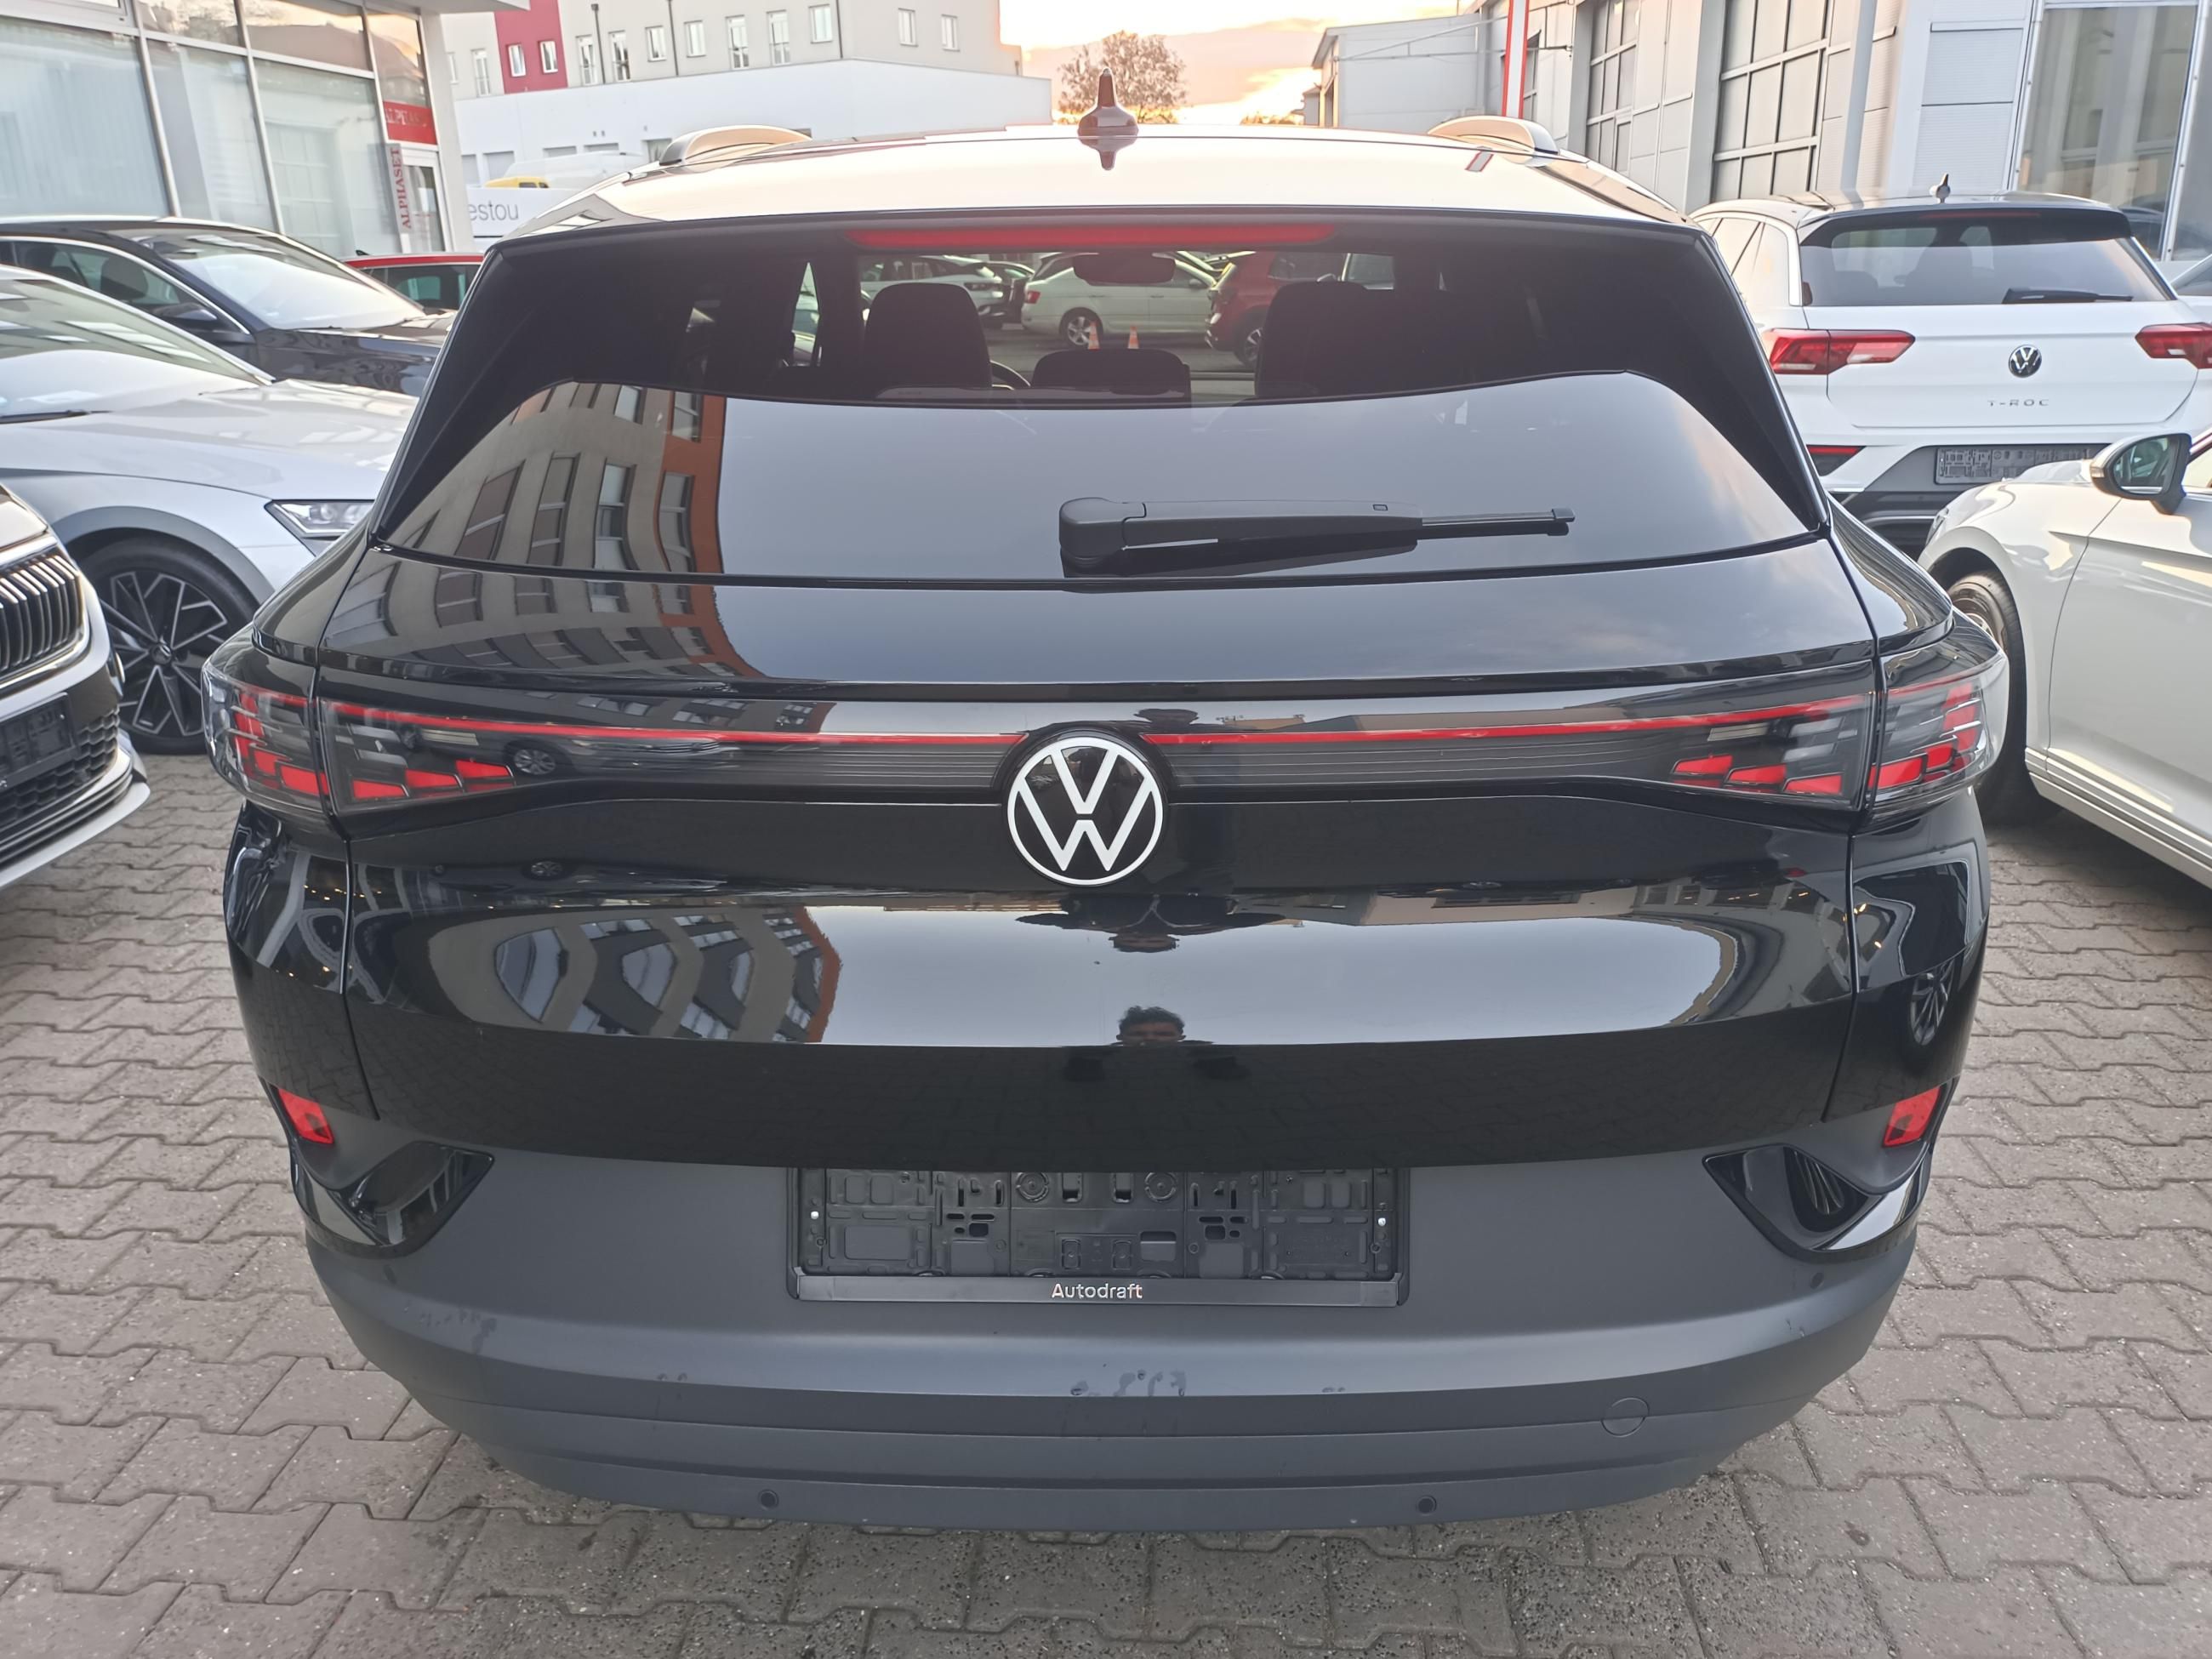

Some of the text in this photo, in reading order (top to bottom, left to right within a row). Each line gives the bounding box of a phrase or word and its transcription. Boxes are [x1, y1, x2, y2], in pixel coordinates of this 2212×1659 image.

[391, 147, 412, 229] ALPHASET
[1987, 398, 2050, 407] T-ROC
[1052, 1283, 1143, 1299] Autodraft
